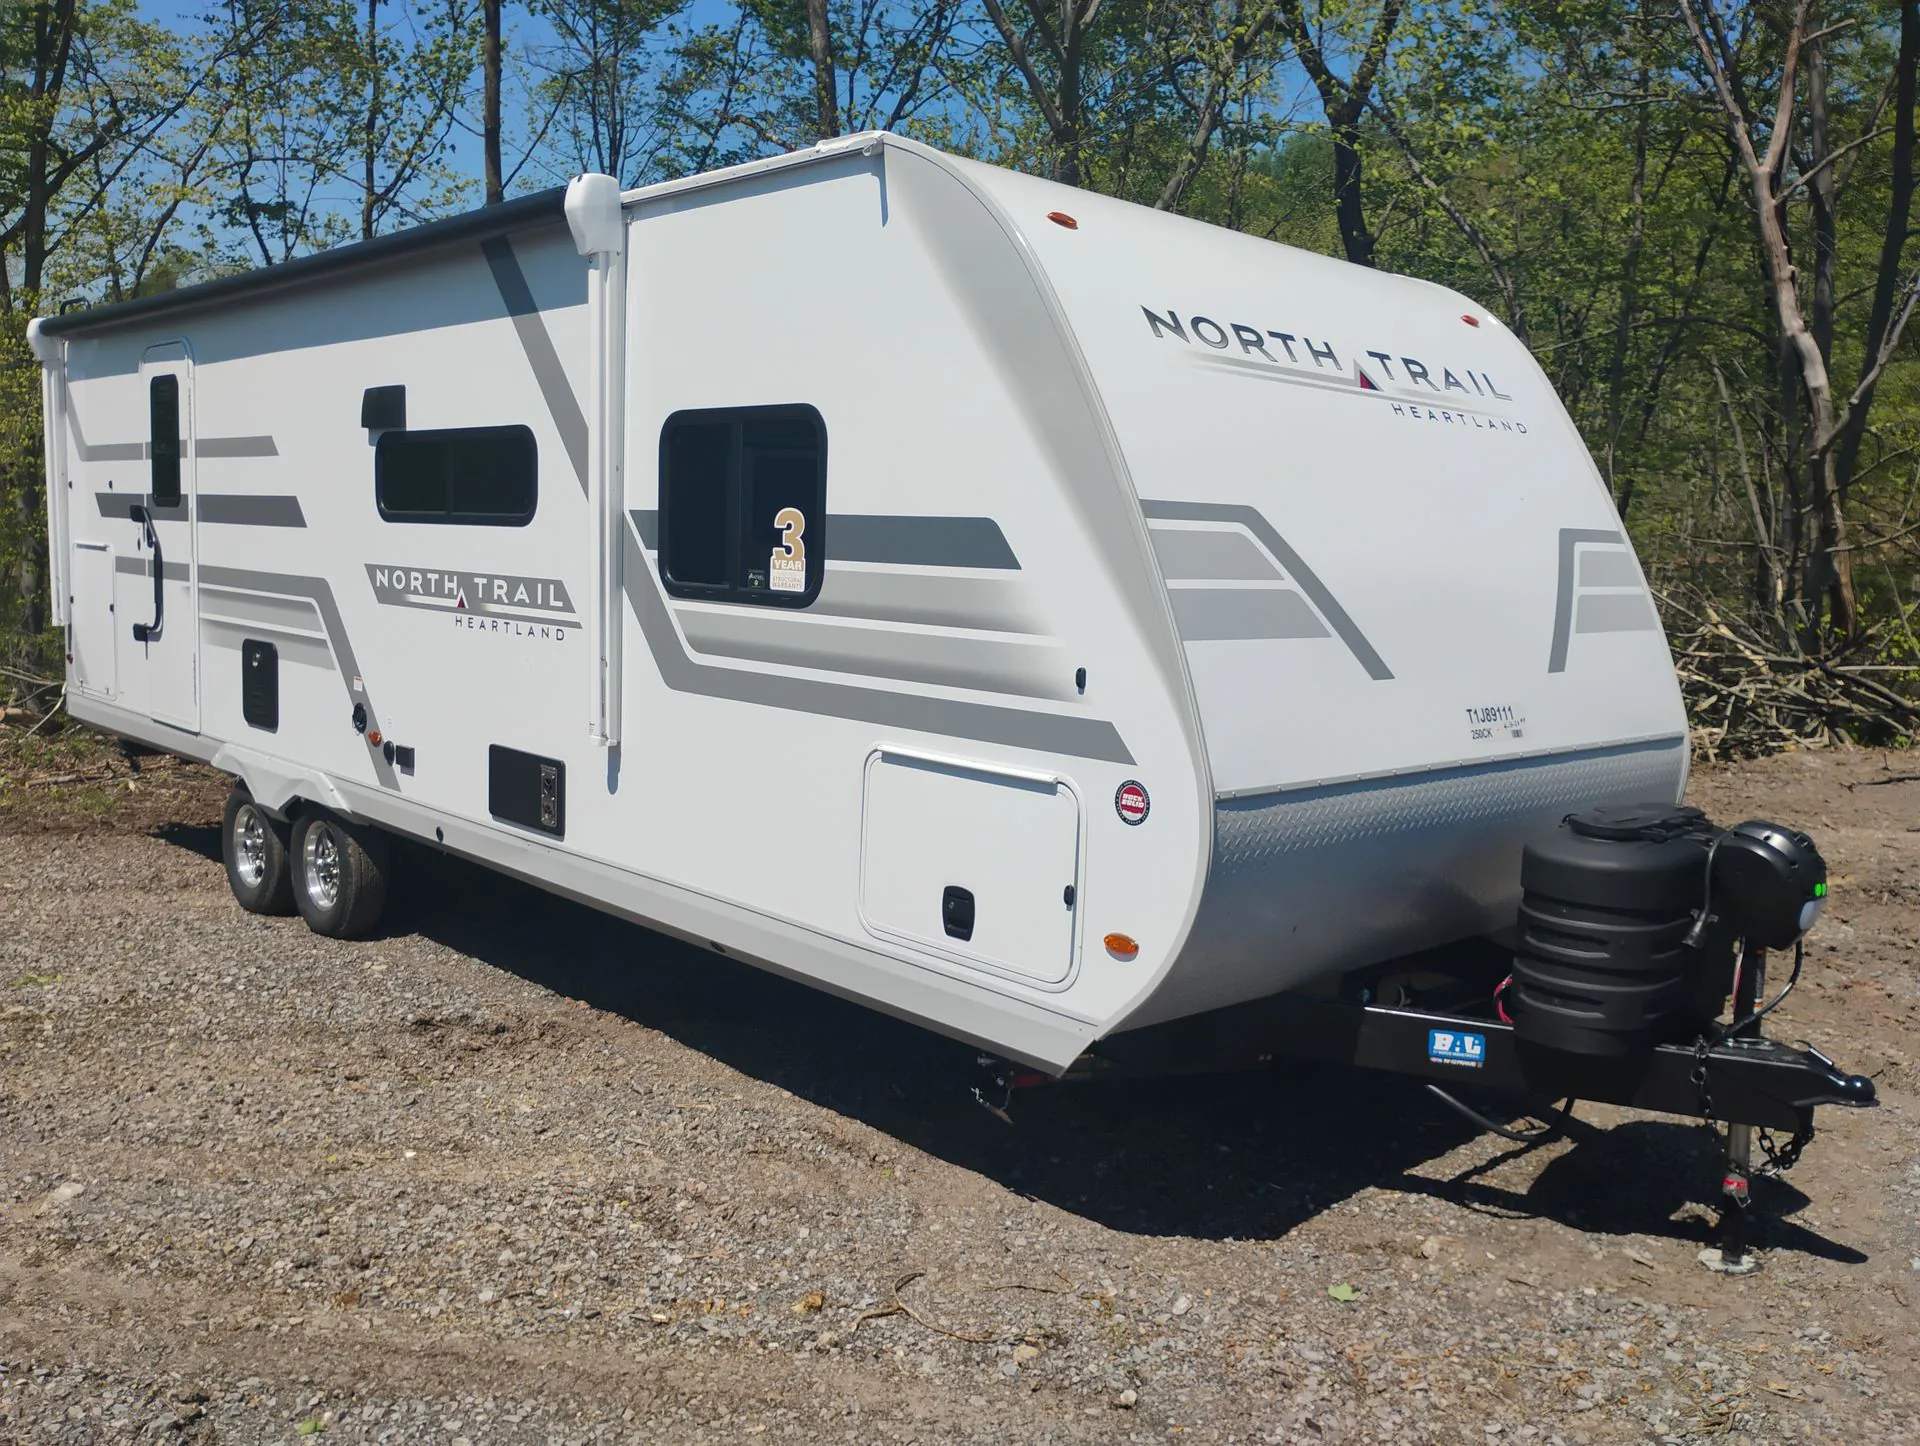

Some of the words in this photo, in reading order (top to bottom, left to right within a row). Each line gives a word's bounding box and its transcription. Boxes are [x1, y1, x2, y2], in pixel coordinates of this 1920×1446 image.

[1140, 304, 1343, 371] NORTH
[1366, 350, 1513, 401] TRAIL
[1391, 402, 1528, 434] HEARTLAND
[773, 507, 805, 560] 3
[774, 560, 802, 570] YEAR
[376, 568, 458, 595] NORTH
[474, 577, 564, 607] TRAIL
[455, 616, 565, 641] HEARTLAND
[1466, 705, 1514, 724] T1J89111
[1121, 799, 1144, 808] SOLID
[1122, 793, 1144, 802] ROCK
